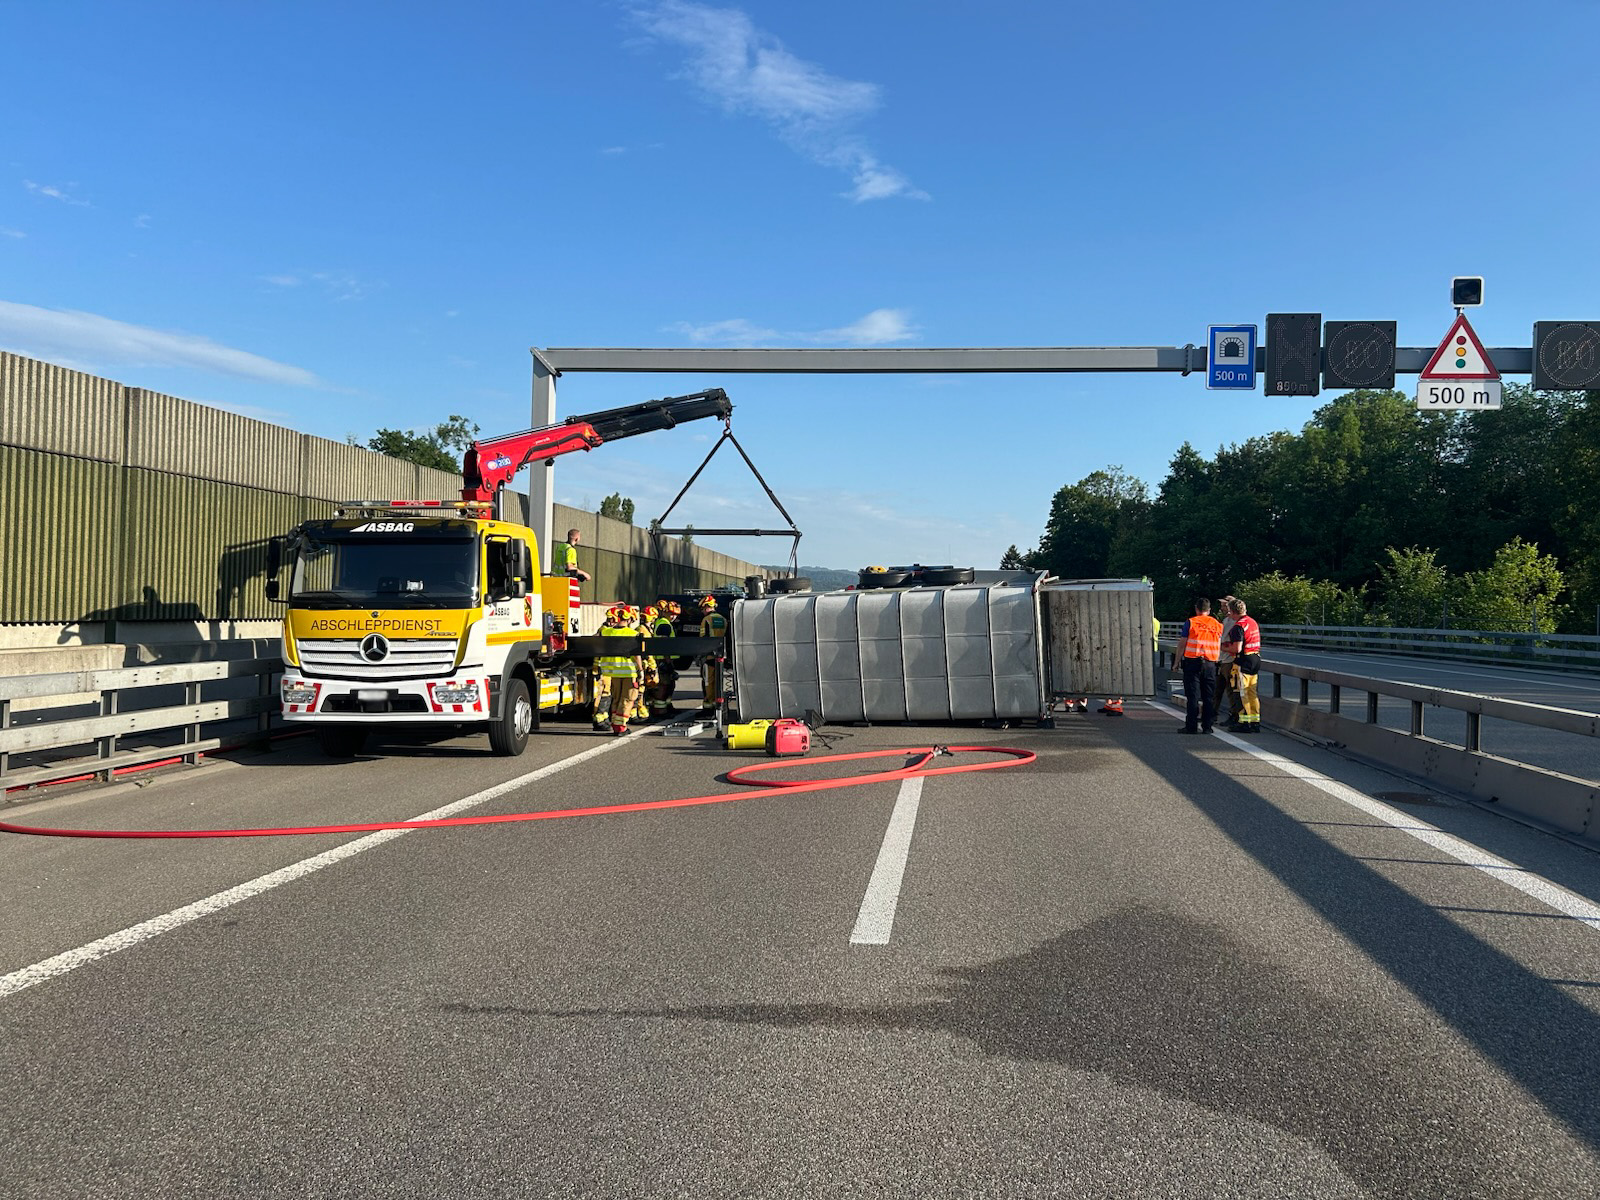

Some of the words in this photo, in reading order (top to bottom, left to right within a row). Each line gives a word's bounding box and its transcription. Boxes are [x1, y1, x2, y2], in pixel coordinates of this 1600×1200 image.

[1215, 370, 1235, 381] 500
[1237, 373, 1248, 381] m
[1429, 387, 1465, 404] 500
[1473, 389, 1490, 404] m
[365, 522, 415, 533] ASBAG
[310, 619, 443, 631] ABSCHLEPPDIENST
